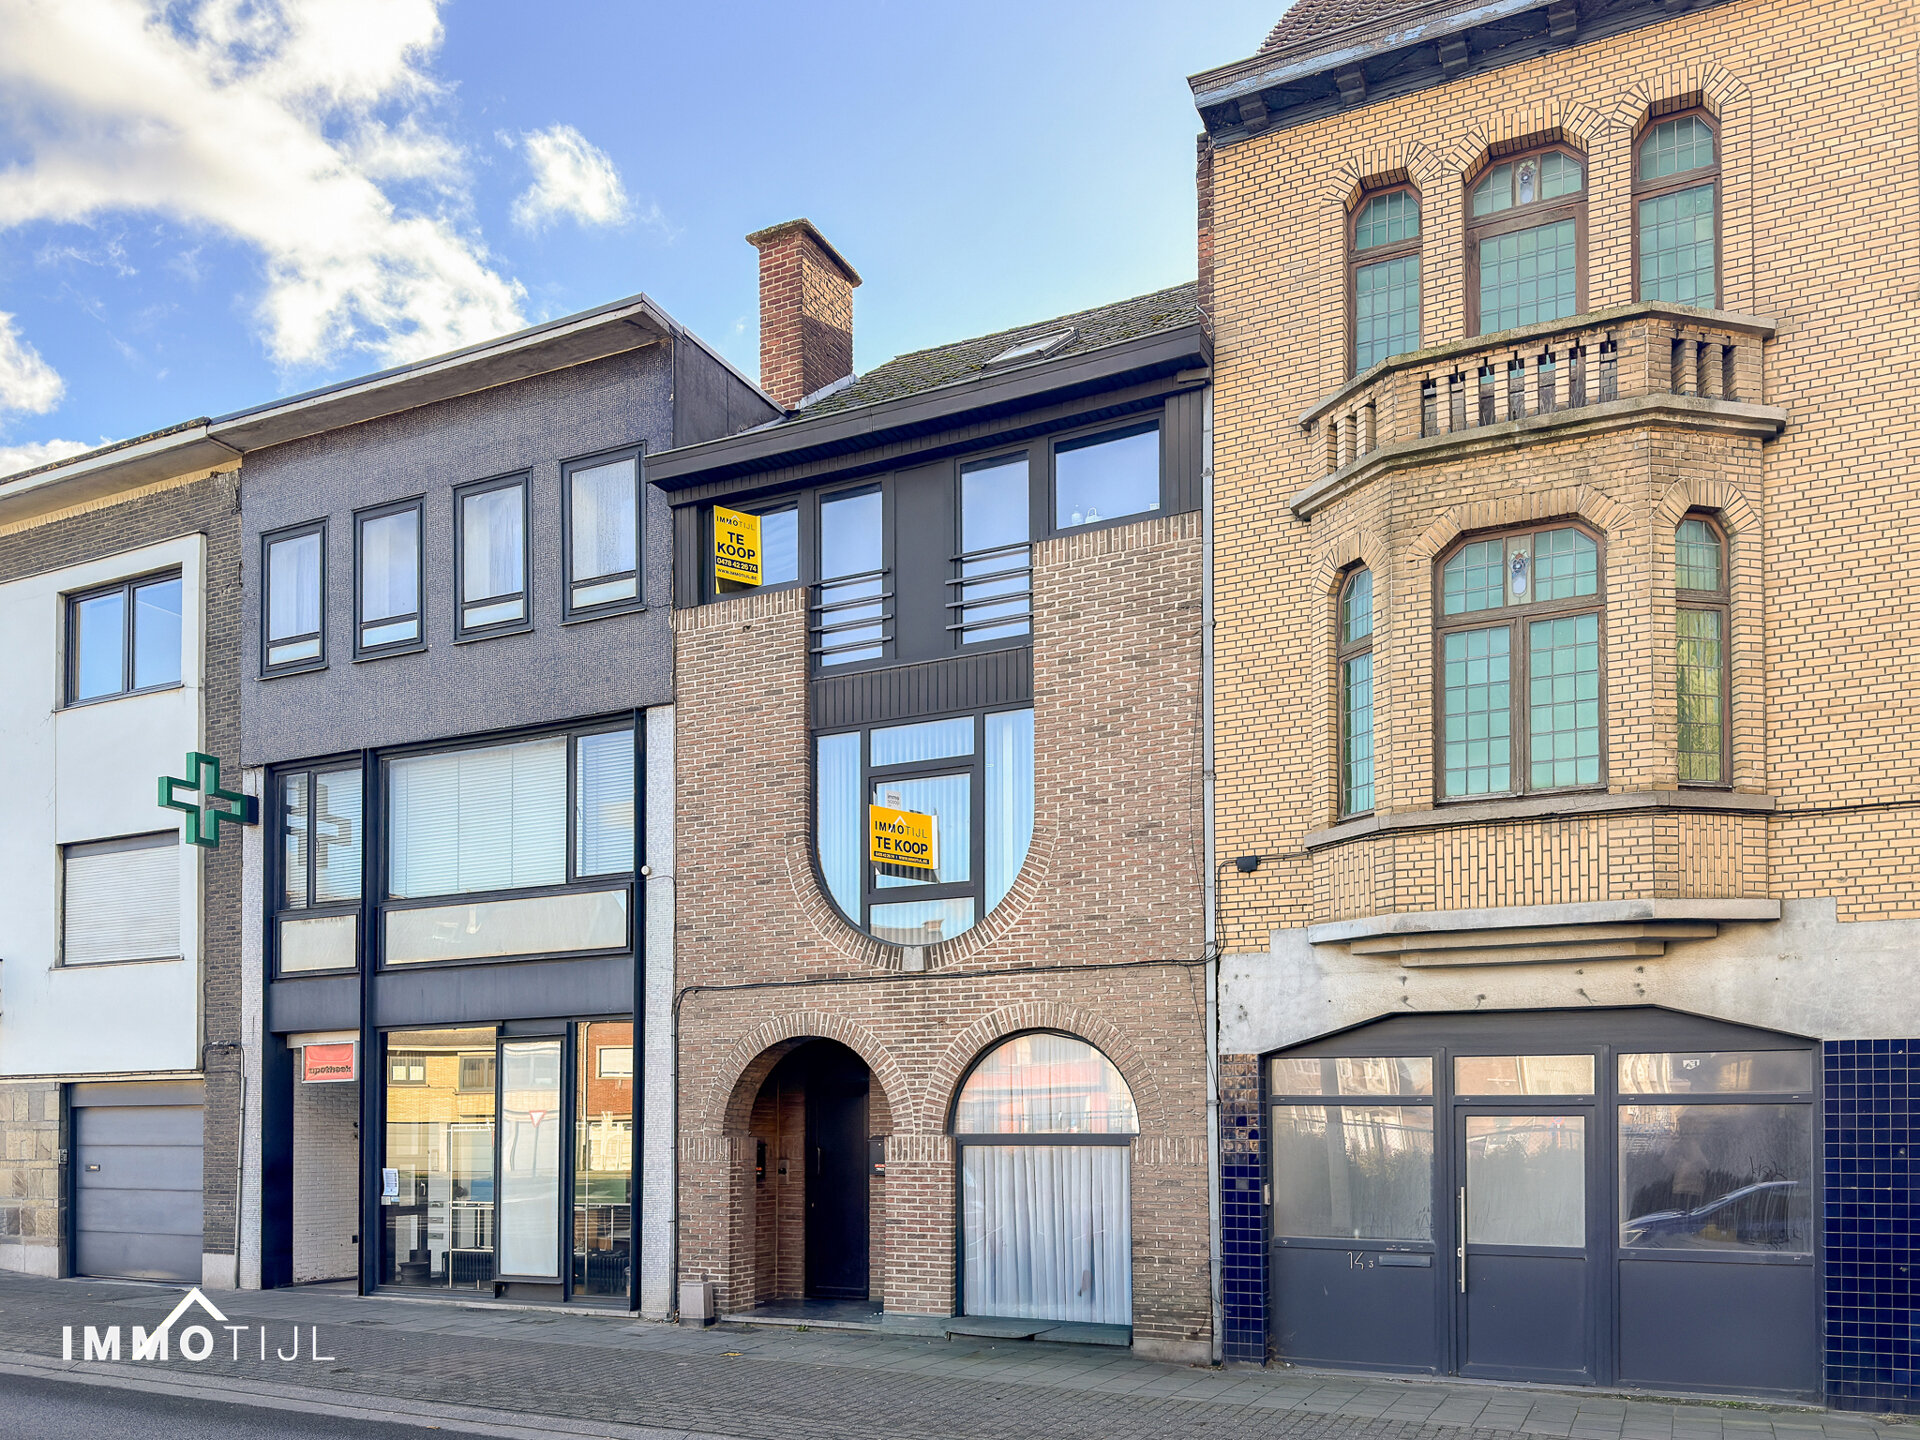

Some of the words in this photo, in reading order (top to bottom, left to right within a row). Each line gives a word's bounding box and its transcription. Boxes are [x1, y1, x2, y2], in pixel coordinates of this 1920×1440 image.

[716, 515, 756, 531] IMMOTIJL
[727, 531, 745, 546] TE
[717, 541, 756, 560] KOOP
[732, 560, 741, 569] 42
[748, 563, 757, 572] 74
[874, 820, 928, 839] IMMOTIJL
[875, 835, 892, 850] TE
[894, 838, 929, 855] KOOP
[308, 1065, 352, 1075] apotheek
